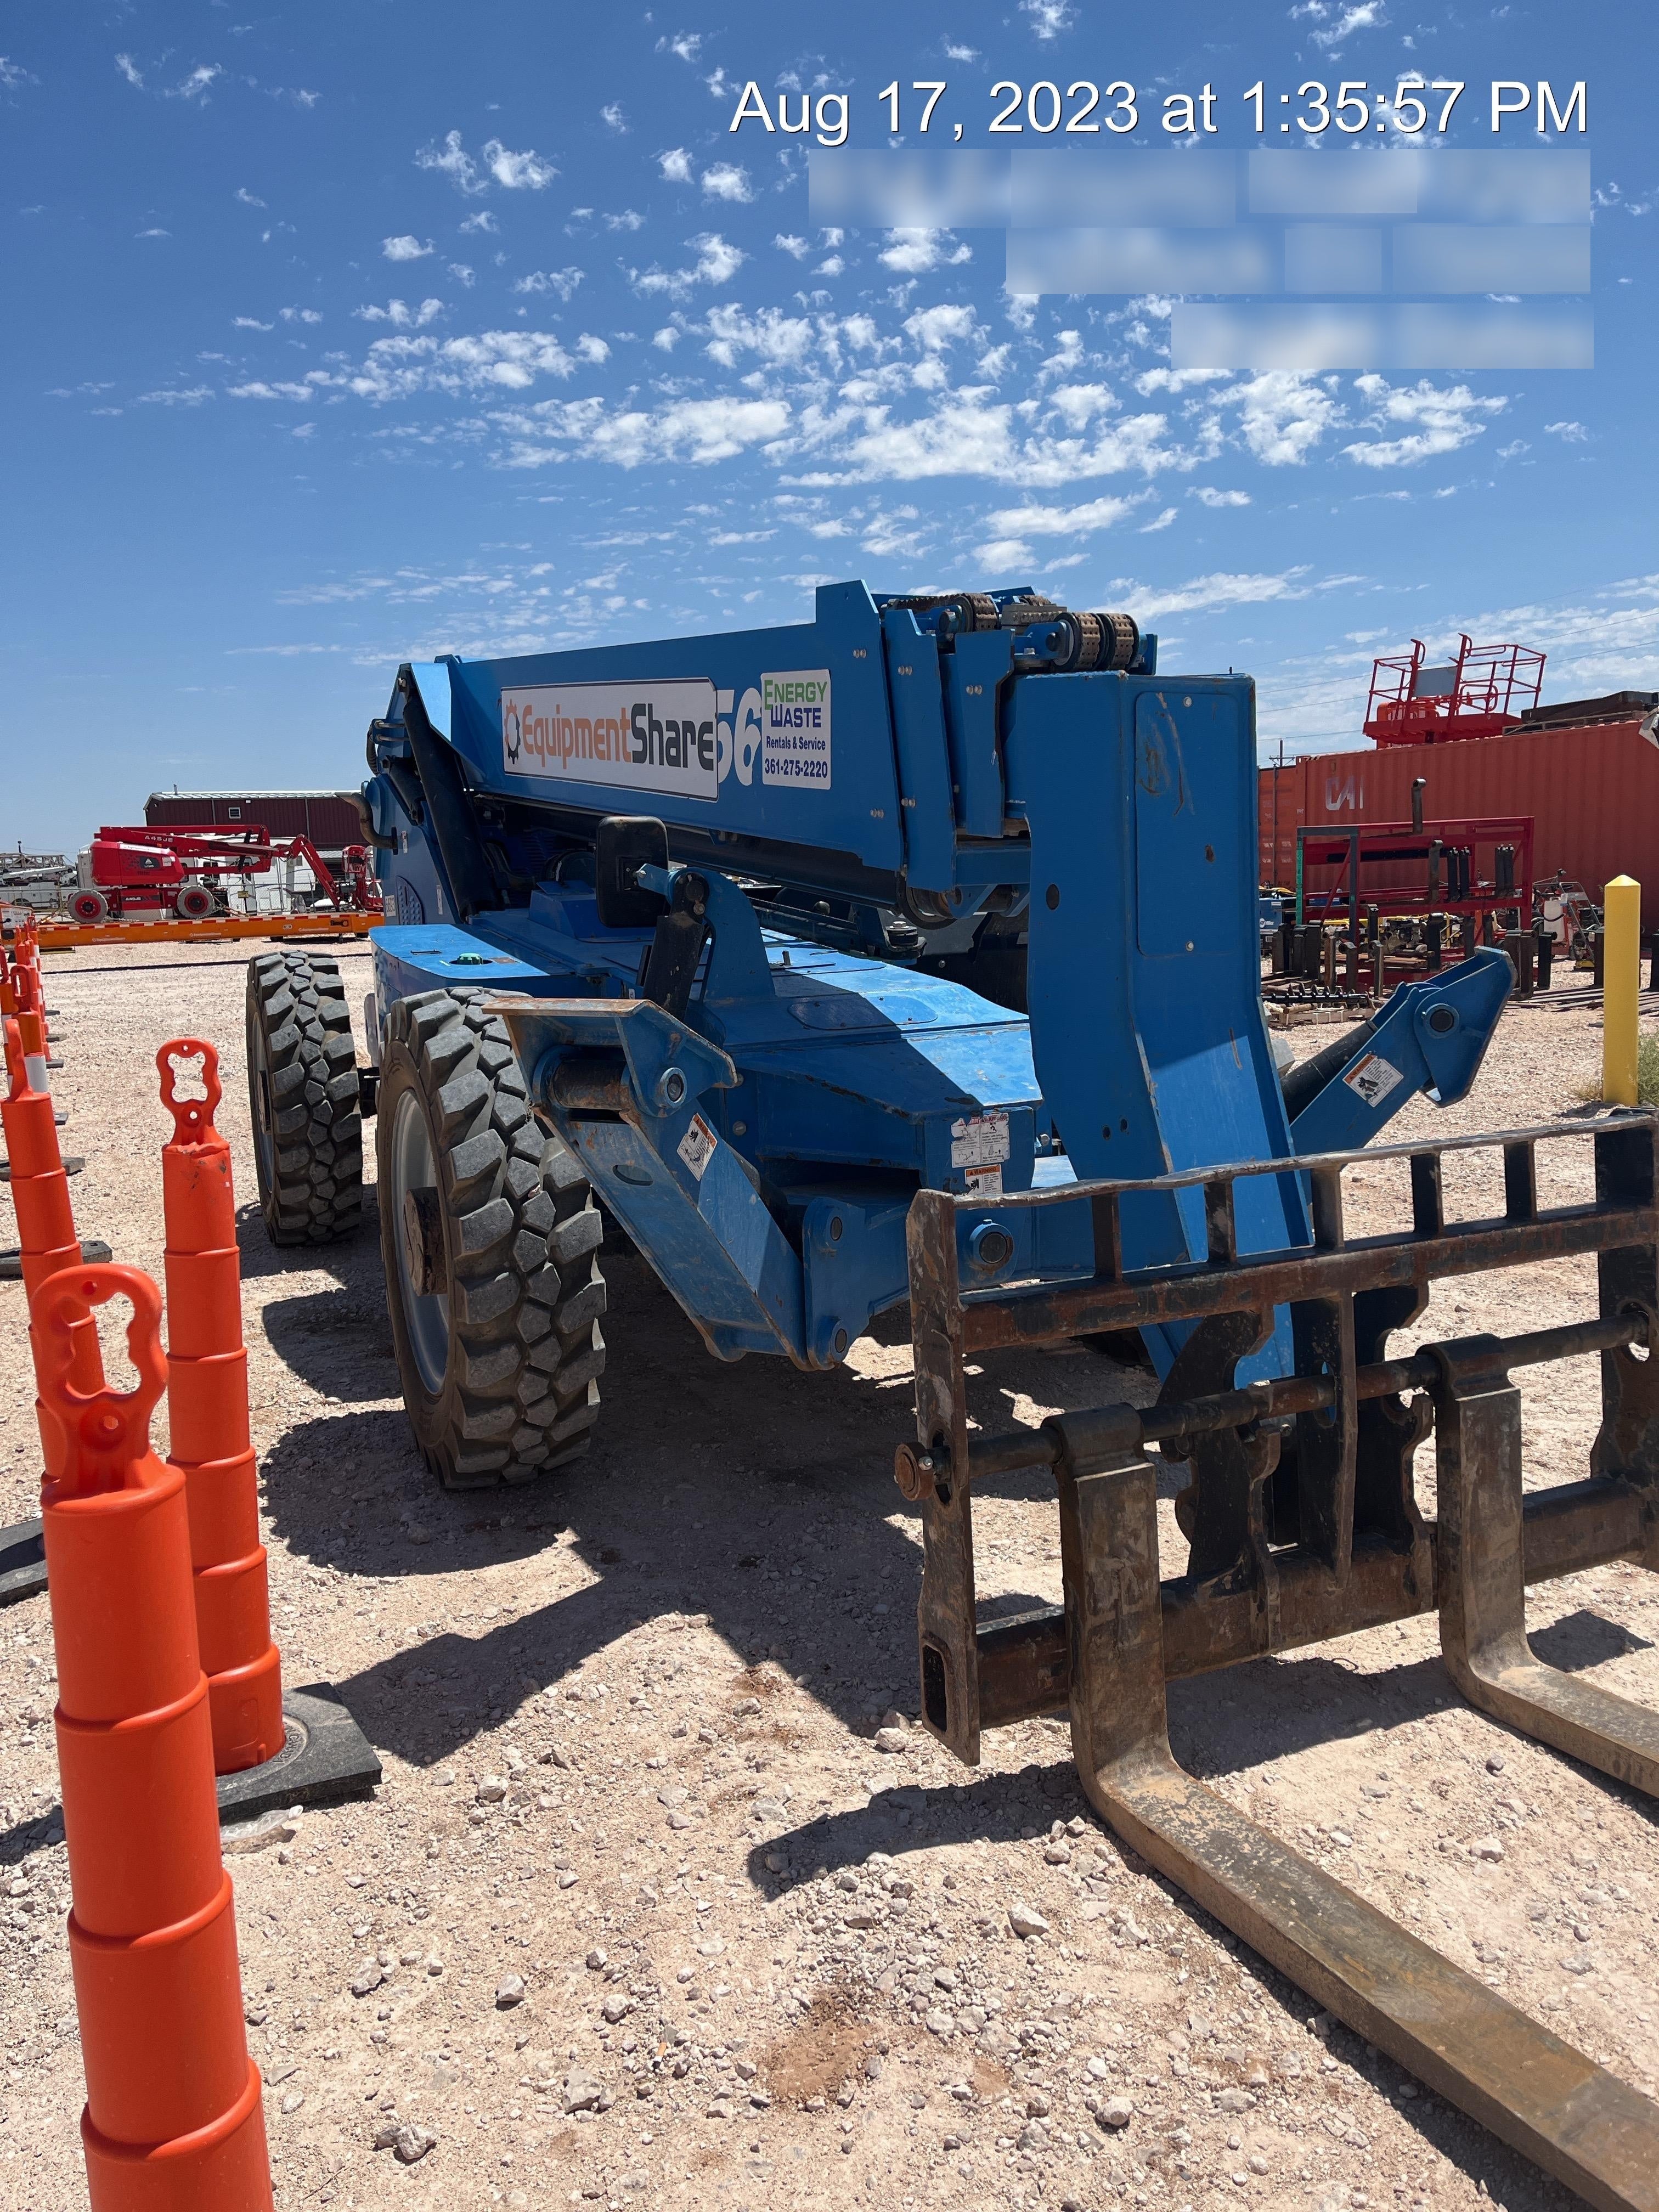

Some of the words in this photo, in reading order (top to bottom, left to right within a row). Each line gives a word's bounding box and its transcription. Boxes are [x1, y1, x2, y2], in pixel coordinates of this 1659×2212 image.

[764, 679, 827, 710] ENERGY
[771, 704, 821, 727] WASTE
[522, 703, 714, 771] EquipmentShare
[766, 736, 791, 749] Rentals
[792, 737, 798, 749] &
[799, 736, 826, 751] Service
[765, 758, 828, 778] 361-275-2220
[1326, 775, 1364, 811] CAI
[973, 1167, 997, 1175] WARNING
